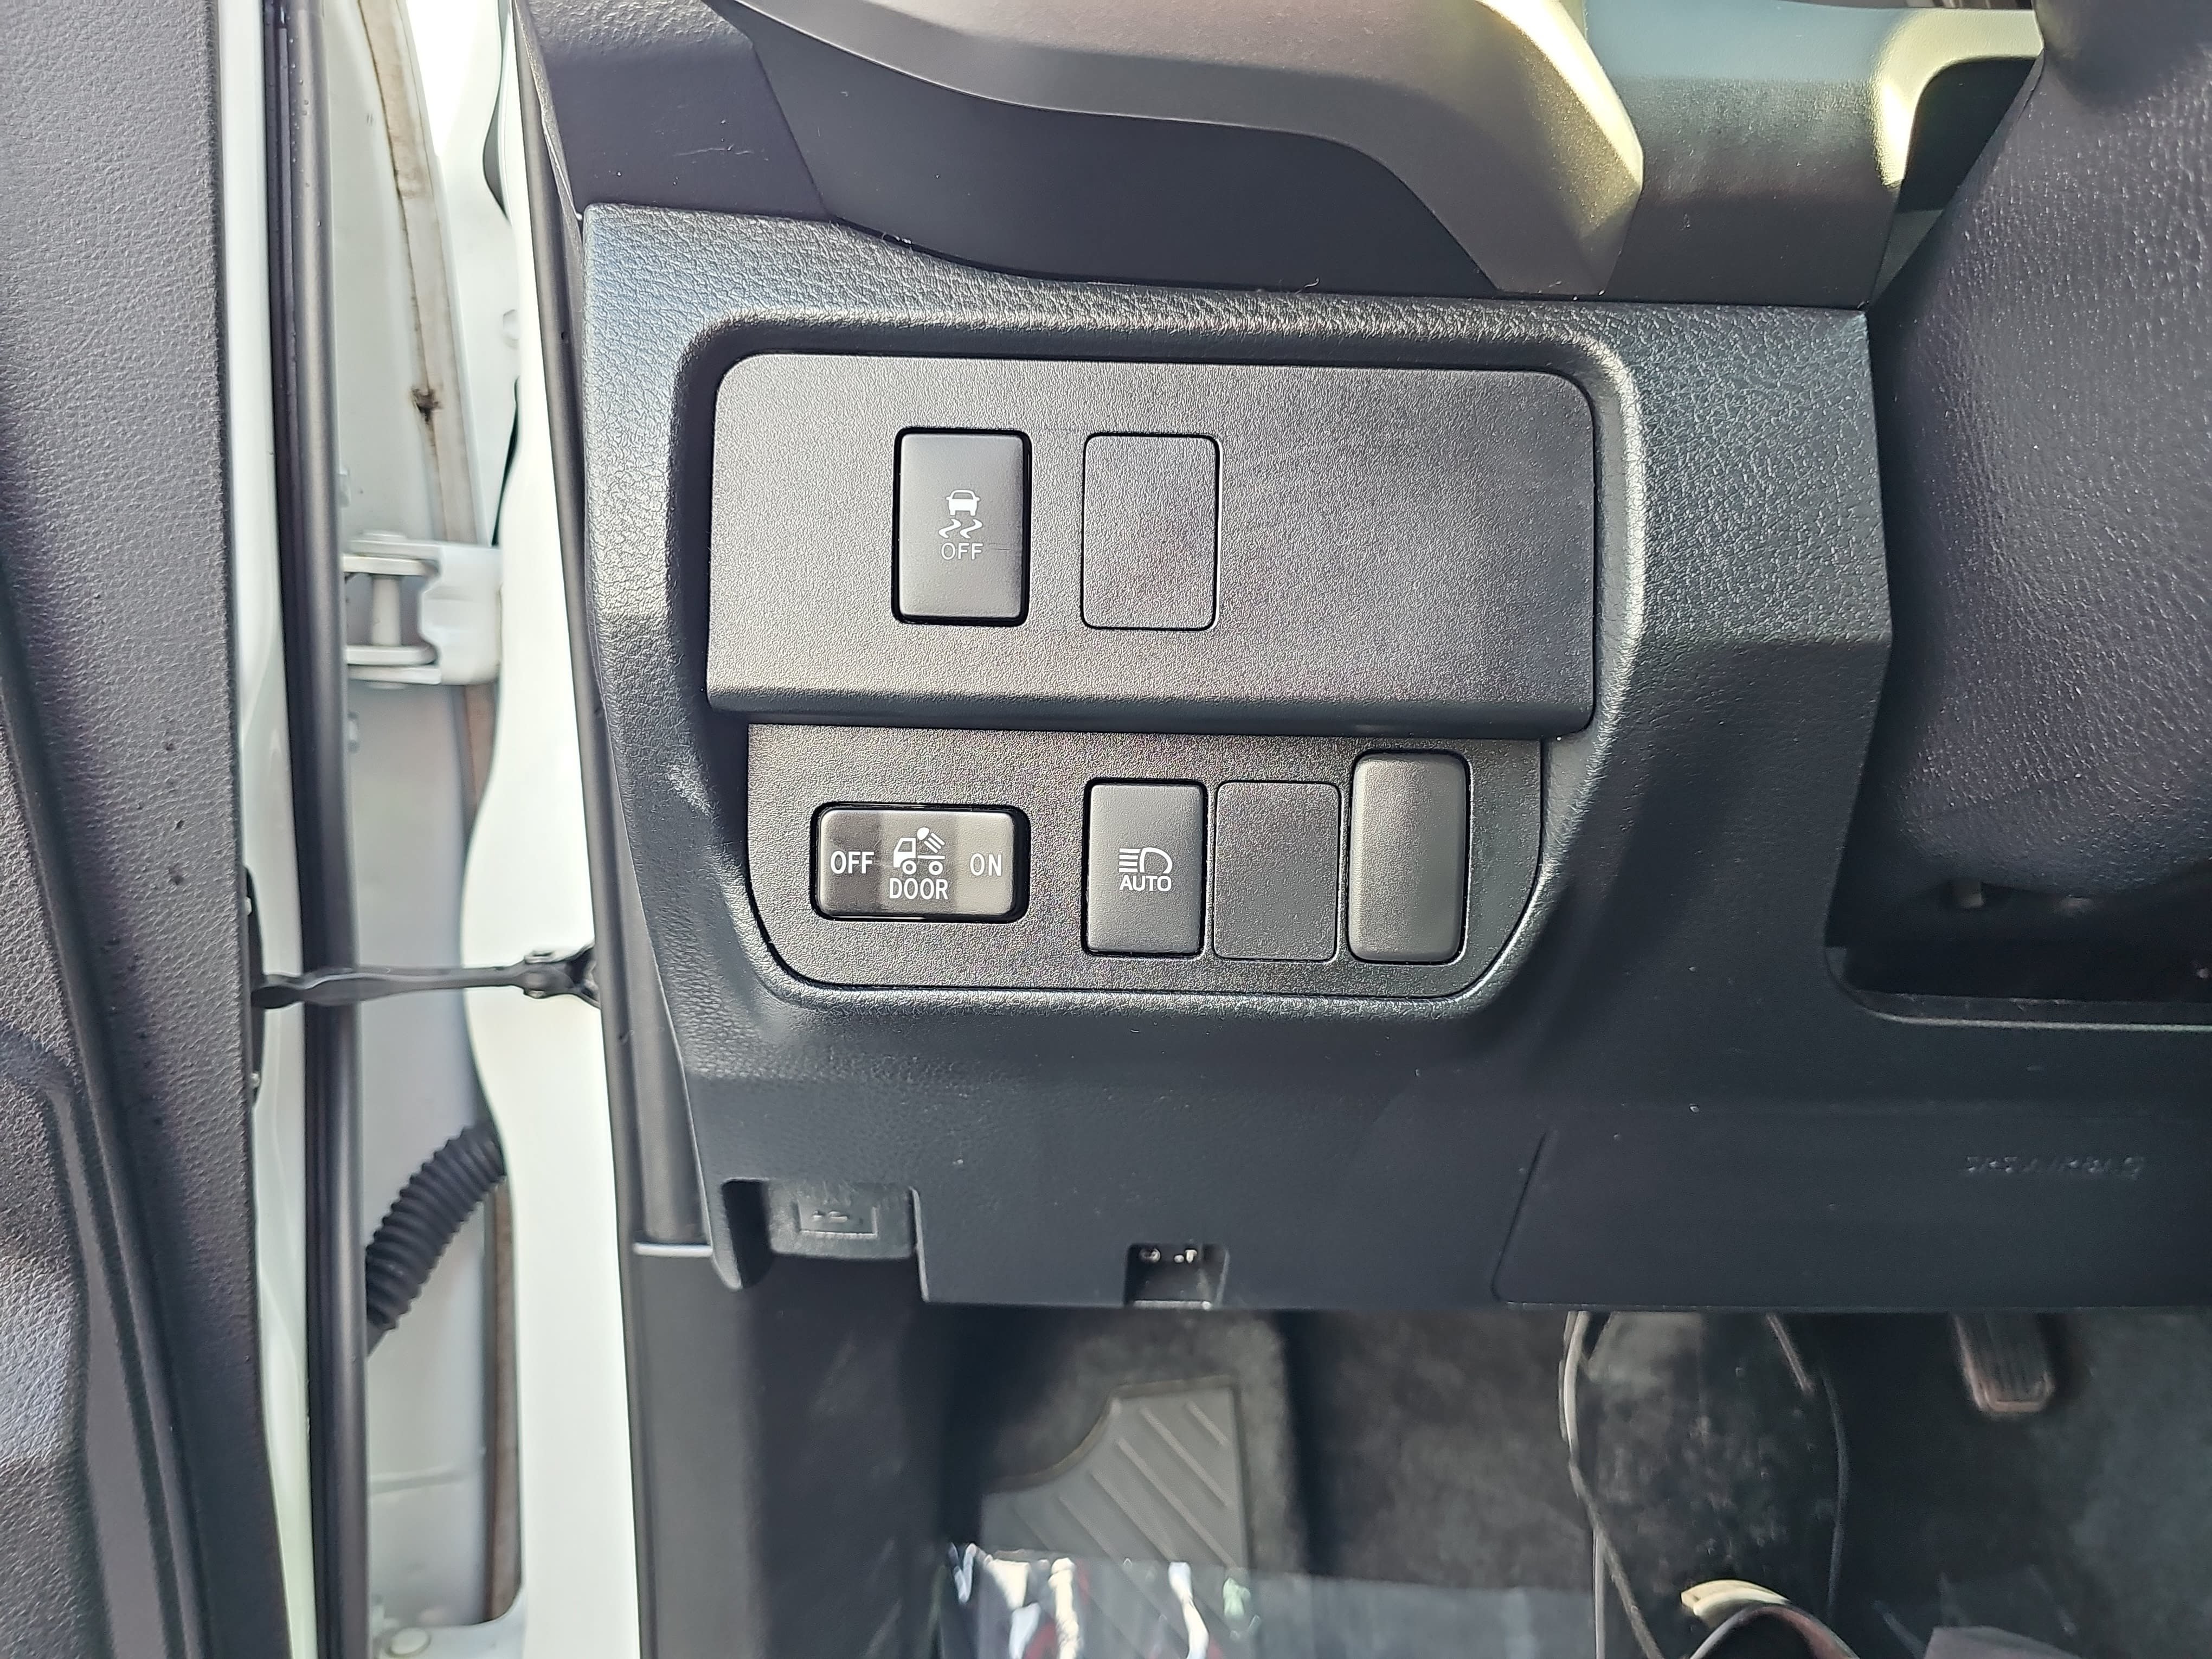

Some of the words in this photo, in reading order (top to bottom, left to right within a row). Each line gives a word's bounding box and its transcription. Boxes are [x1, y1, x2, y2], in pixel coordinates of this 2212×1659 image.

[941, 542, 983, 560] OFF
[830, 850, 874, 874] OFF
[969, 853, 1002, 877] ON
[889, 878, 948, 900] DOOR
[1119, 874, 1172, 892] AUTO
